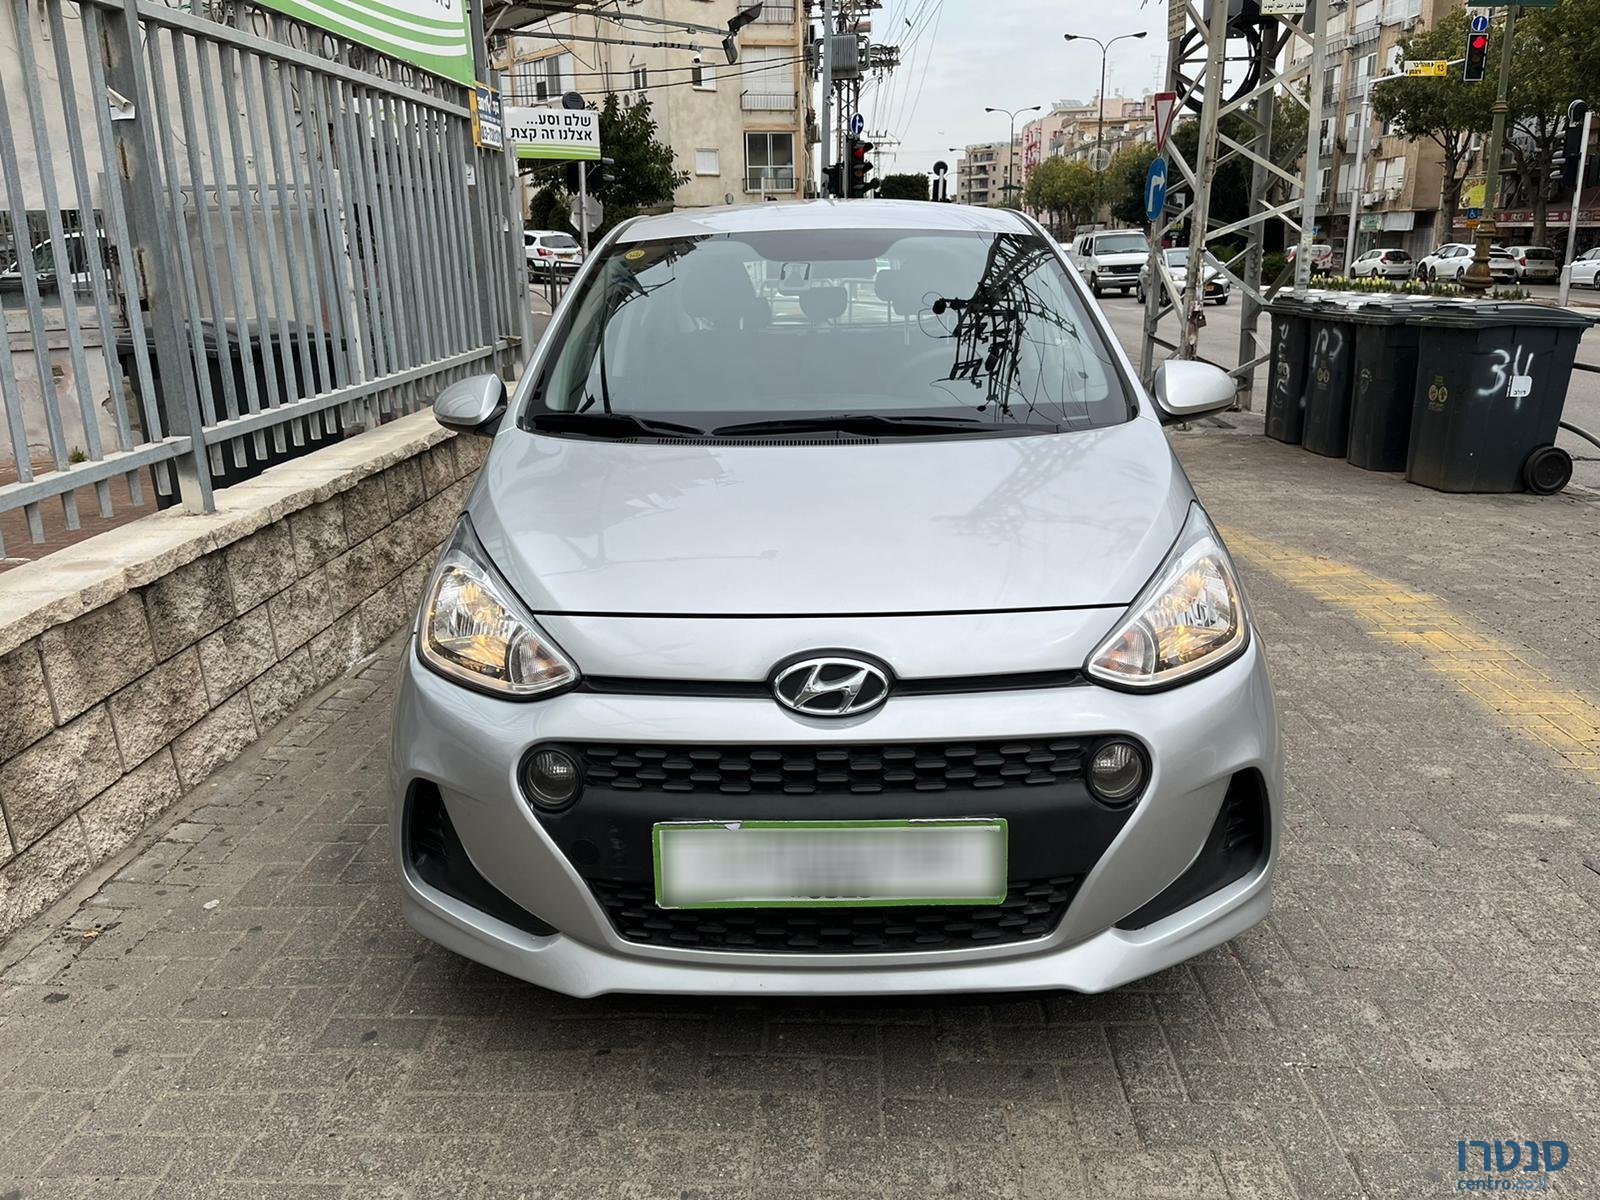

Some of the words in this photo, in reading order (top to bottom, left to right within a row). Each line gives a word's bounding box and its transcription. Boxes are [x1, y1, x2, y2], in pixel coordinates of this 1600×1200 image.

[1437, 64, 1444, 72] 13
[526, 114, 560, 126] וסע...
[564, 113, 591, 127] שלם
[511, 127, 537, 142] קצת
[541, 128, 555, 140] זה
[559, 127, 592, 141] אצלנו
